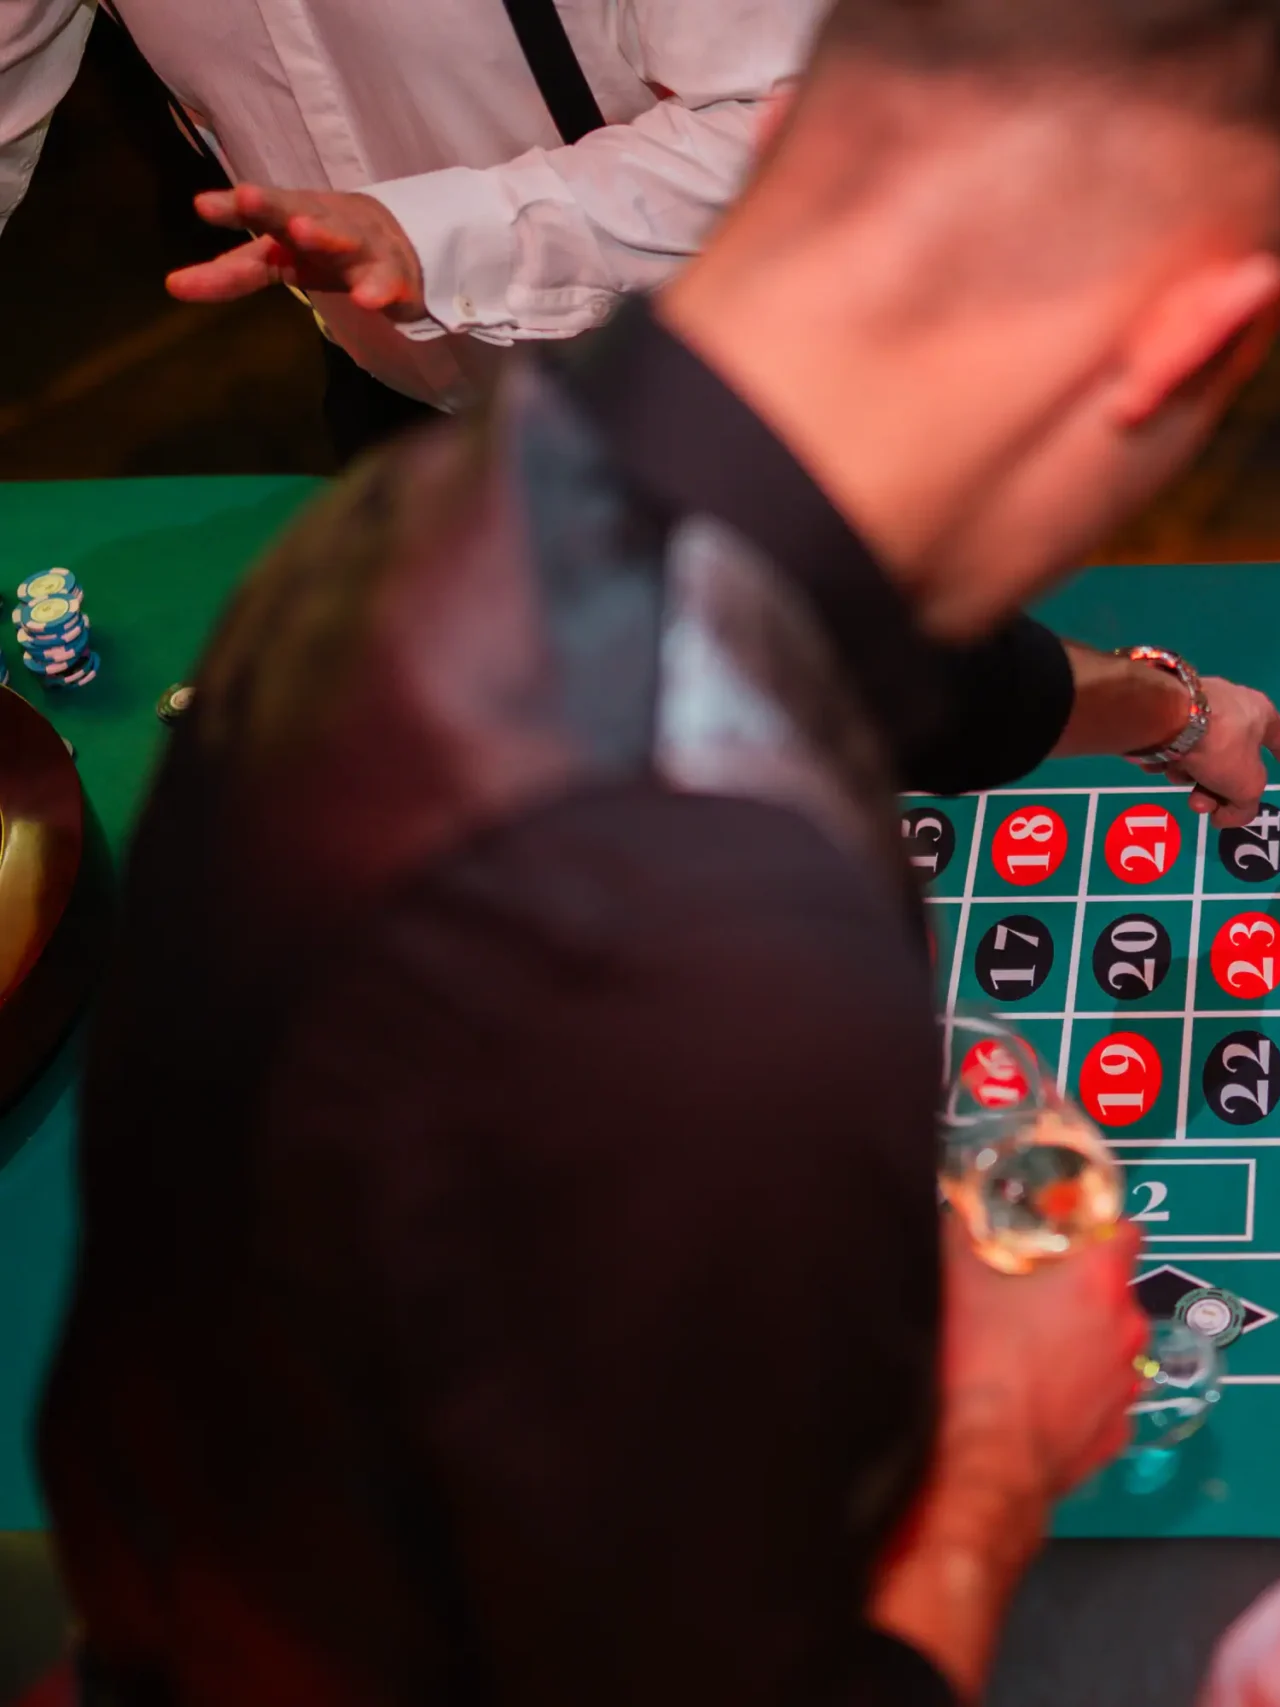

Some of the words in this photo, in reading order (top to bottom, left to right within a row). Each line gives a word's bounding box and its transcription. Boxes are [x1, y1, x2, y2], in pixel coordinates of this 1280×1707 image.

[1007, 813, 1054, 874] 18
[1120, 812, 1168, 873] 21
[1234, 808, 1280, 871] 24
[989, 923, 1040, 990] 17
[1107, 920, 1158, 991] 20
[1227, 920, 1275, 990] 23
[974, 1046, 1020, 1103] 16
[1097, 1044, 1146, 1116] 19
[1220, 1039, 1270, 1116] 22
[1127, 1181, 1170, 1221] 2
